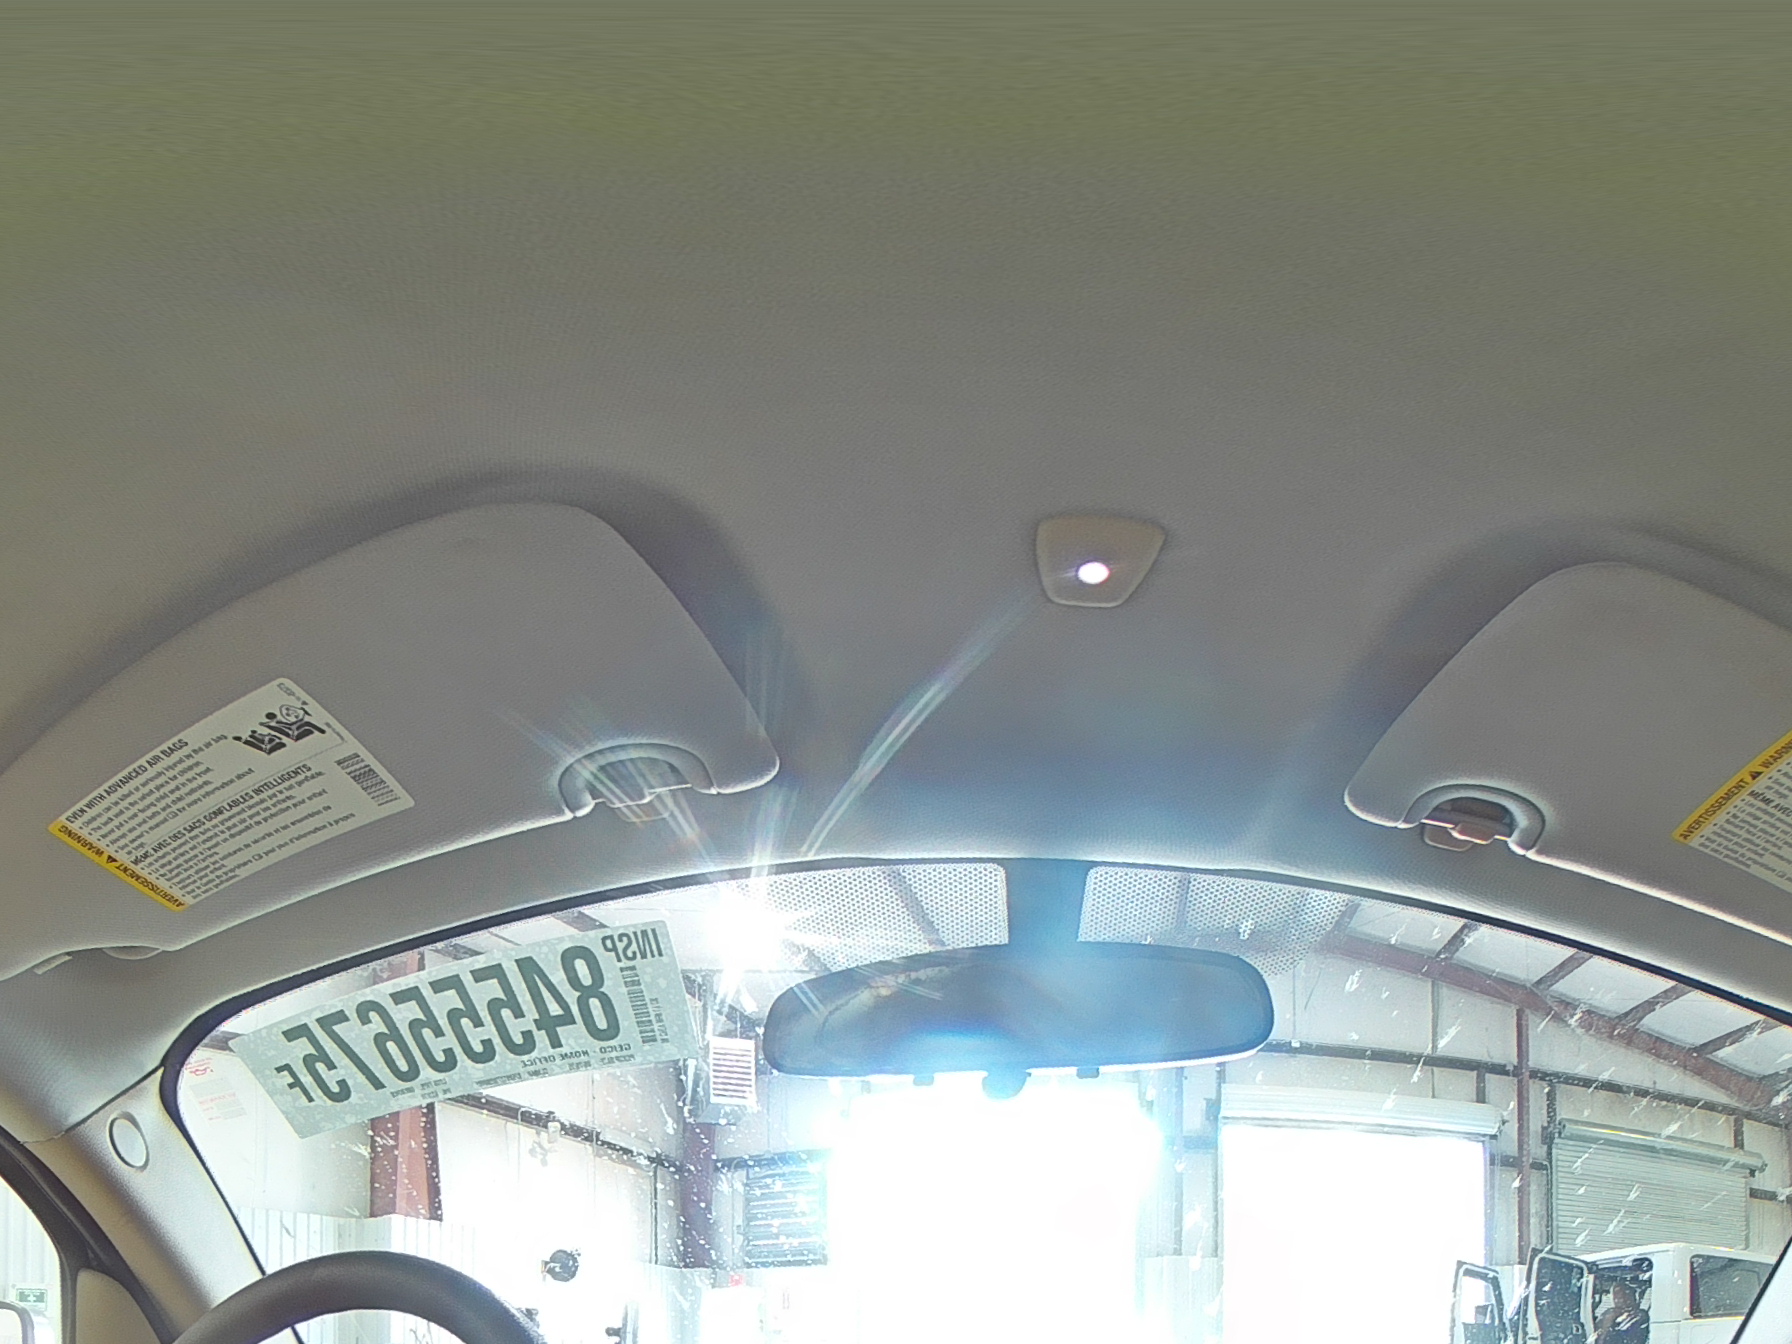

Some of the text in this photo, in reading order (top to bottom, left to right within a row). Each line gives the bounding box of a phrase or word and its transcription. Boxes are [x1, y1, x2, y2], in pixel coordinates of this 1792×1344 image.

[64, 737, 189, 823] EVEN WITH ADVANCED AIR BAGS
[148, 838, 173, 853] AVEC
[166, 829, 187, 842] DES
[181, 818, 206, 833] SACS
[250, 761, 313, 798] INTELLIGENTS
[1677, 777, 1751, 840] AVERTISSEMENT
[56, 824, 107, 857] WARNING
[113, 862, 185, 908] AVERTISSEMENT
